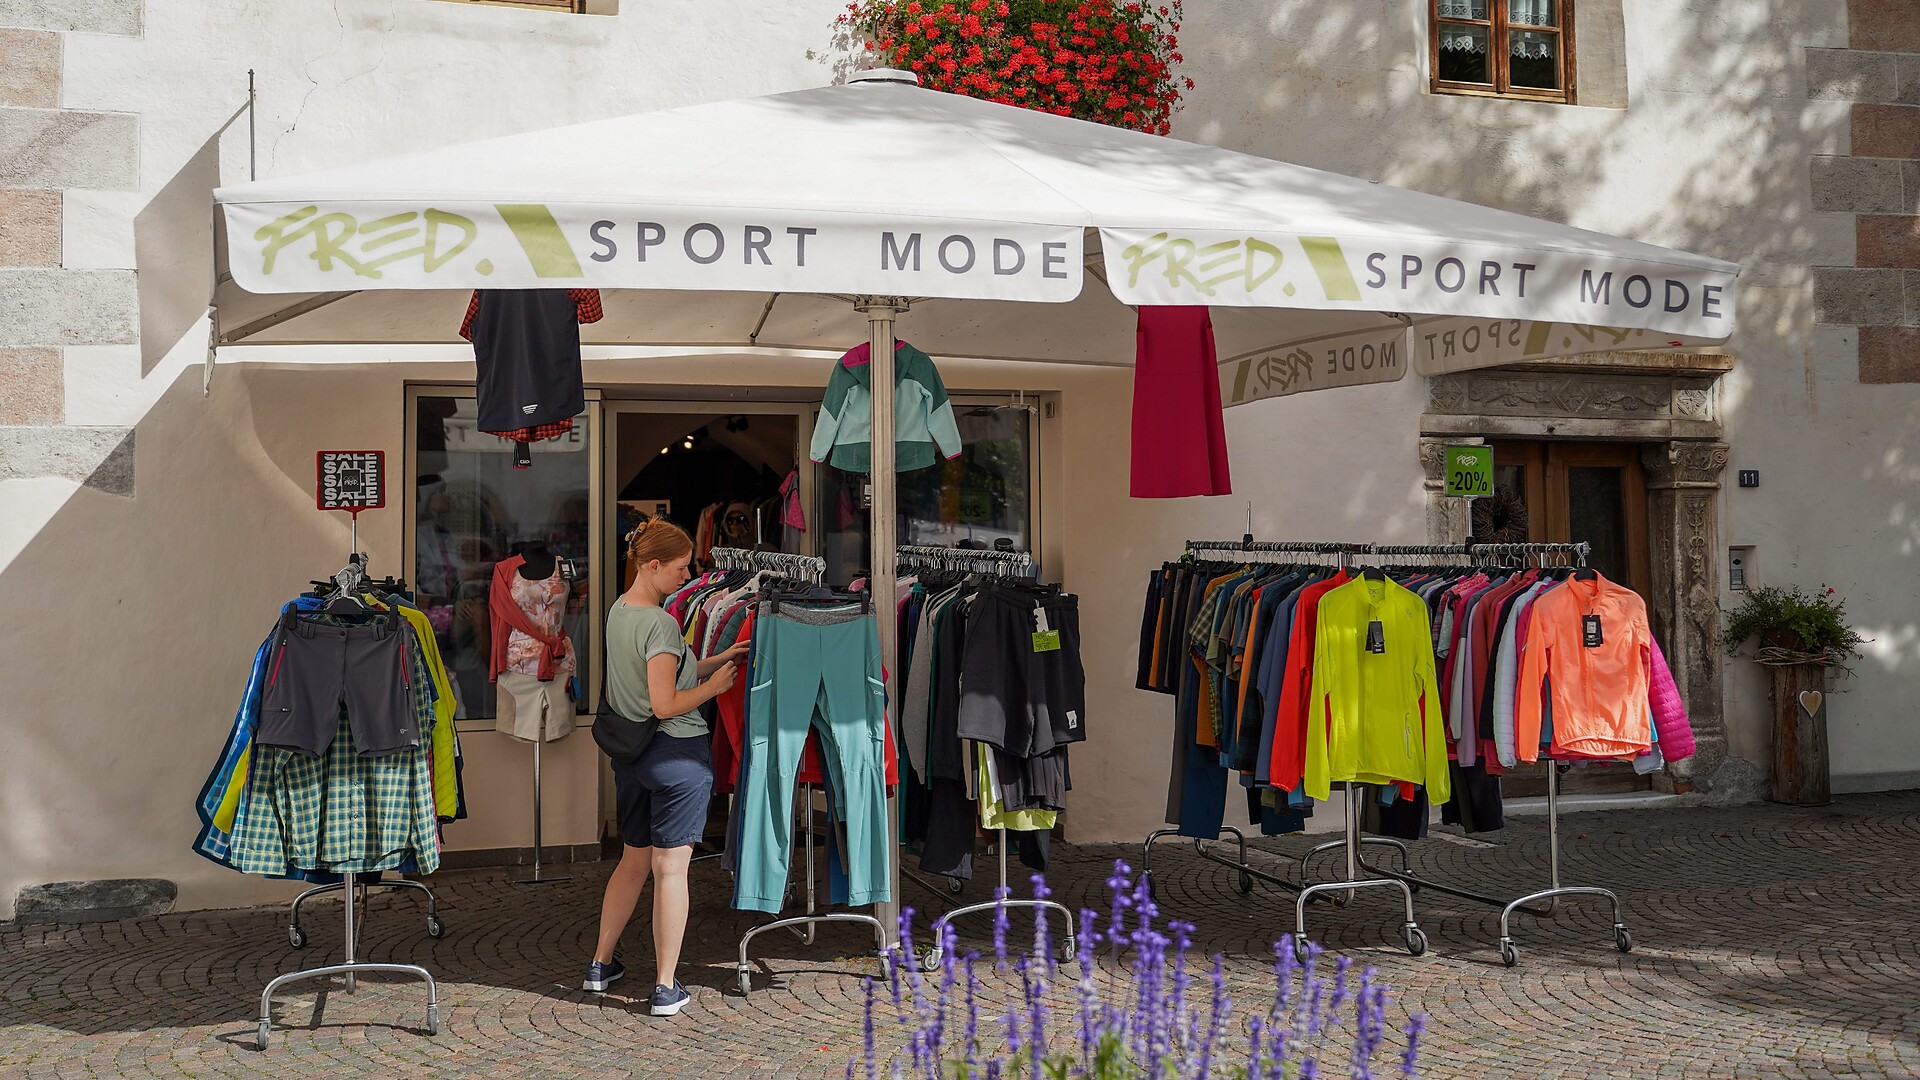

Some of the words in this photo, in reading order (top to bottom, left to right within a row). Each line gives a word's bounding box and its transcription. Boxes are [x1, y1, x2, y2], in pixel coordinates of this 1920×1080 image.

[589, 220, 817, 267] SPORT
[881, 231, 1068, 279] MODE
[1365, 252, 1536, 298] SPORT
[1580, 269, 1723, 319] MODE
[324, 461, 377, 474] SALE
[324, 474, 377, 487] SE
[1449, 471, 1488, 491] -20%
[1743, 473, 1755, 484] 11
